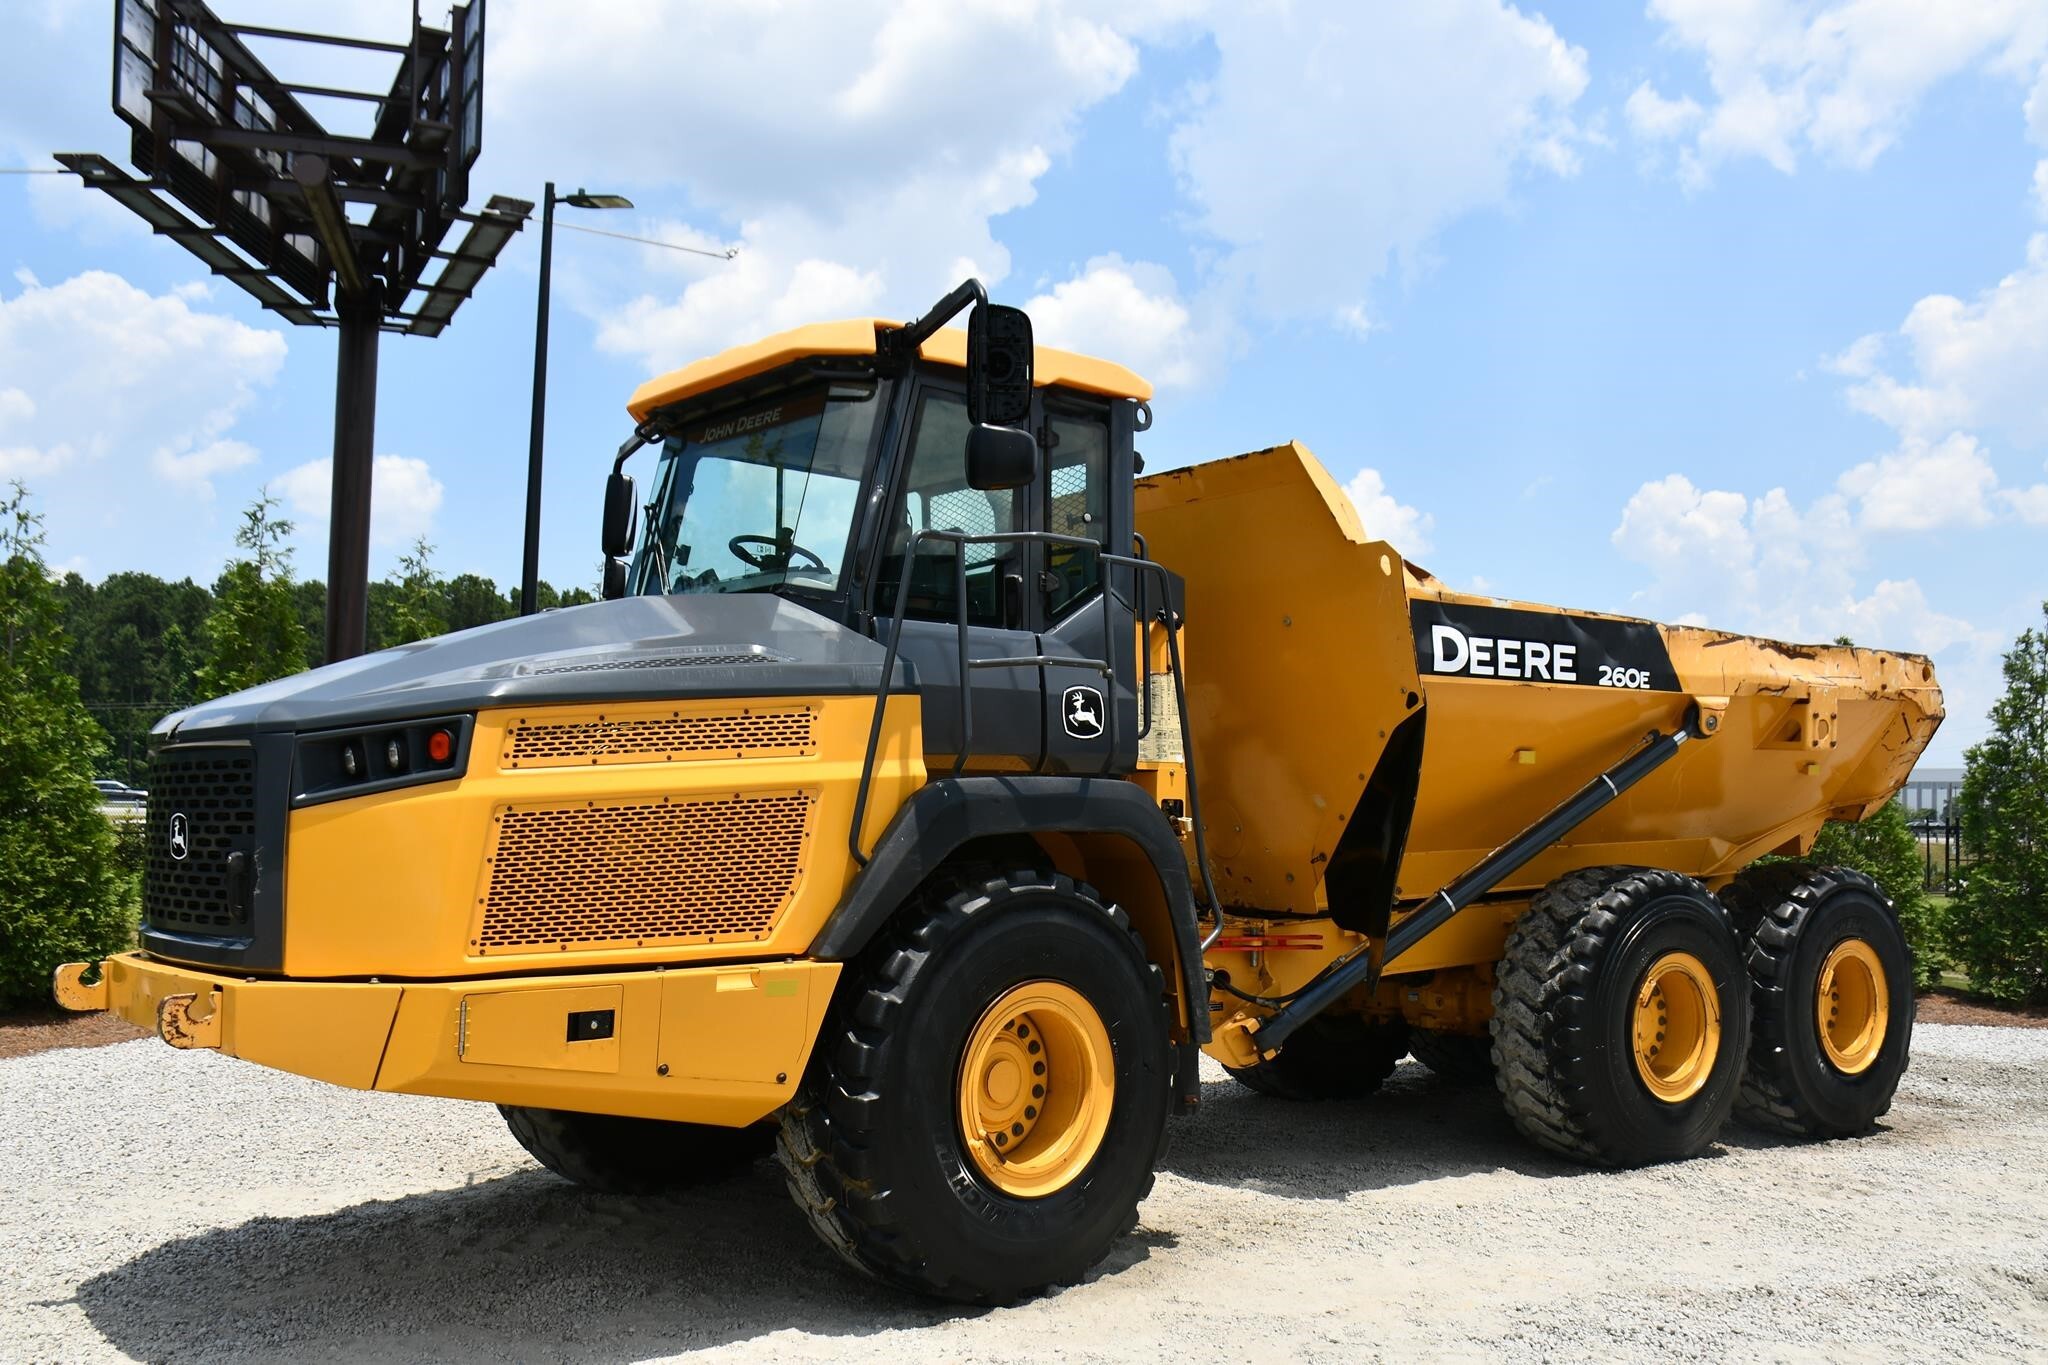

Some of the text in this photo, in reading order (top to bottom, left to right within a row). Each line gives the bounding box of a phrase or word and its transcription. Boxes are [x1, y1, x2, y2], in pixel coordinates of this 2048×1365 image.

[700, 407, 783, 444] JOHN DEERE
[1431, 624, 1650, 689] DEERE 260E
